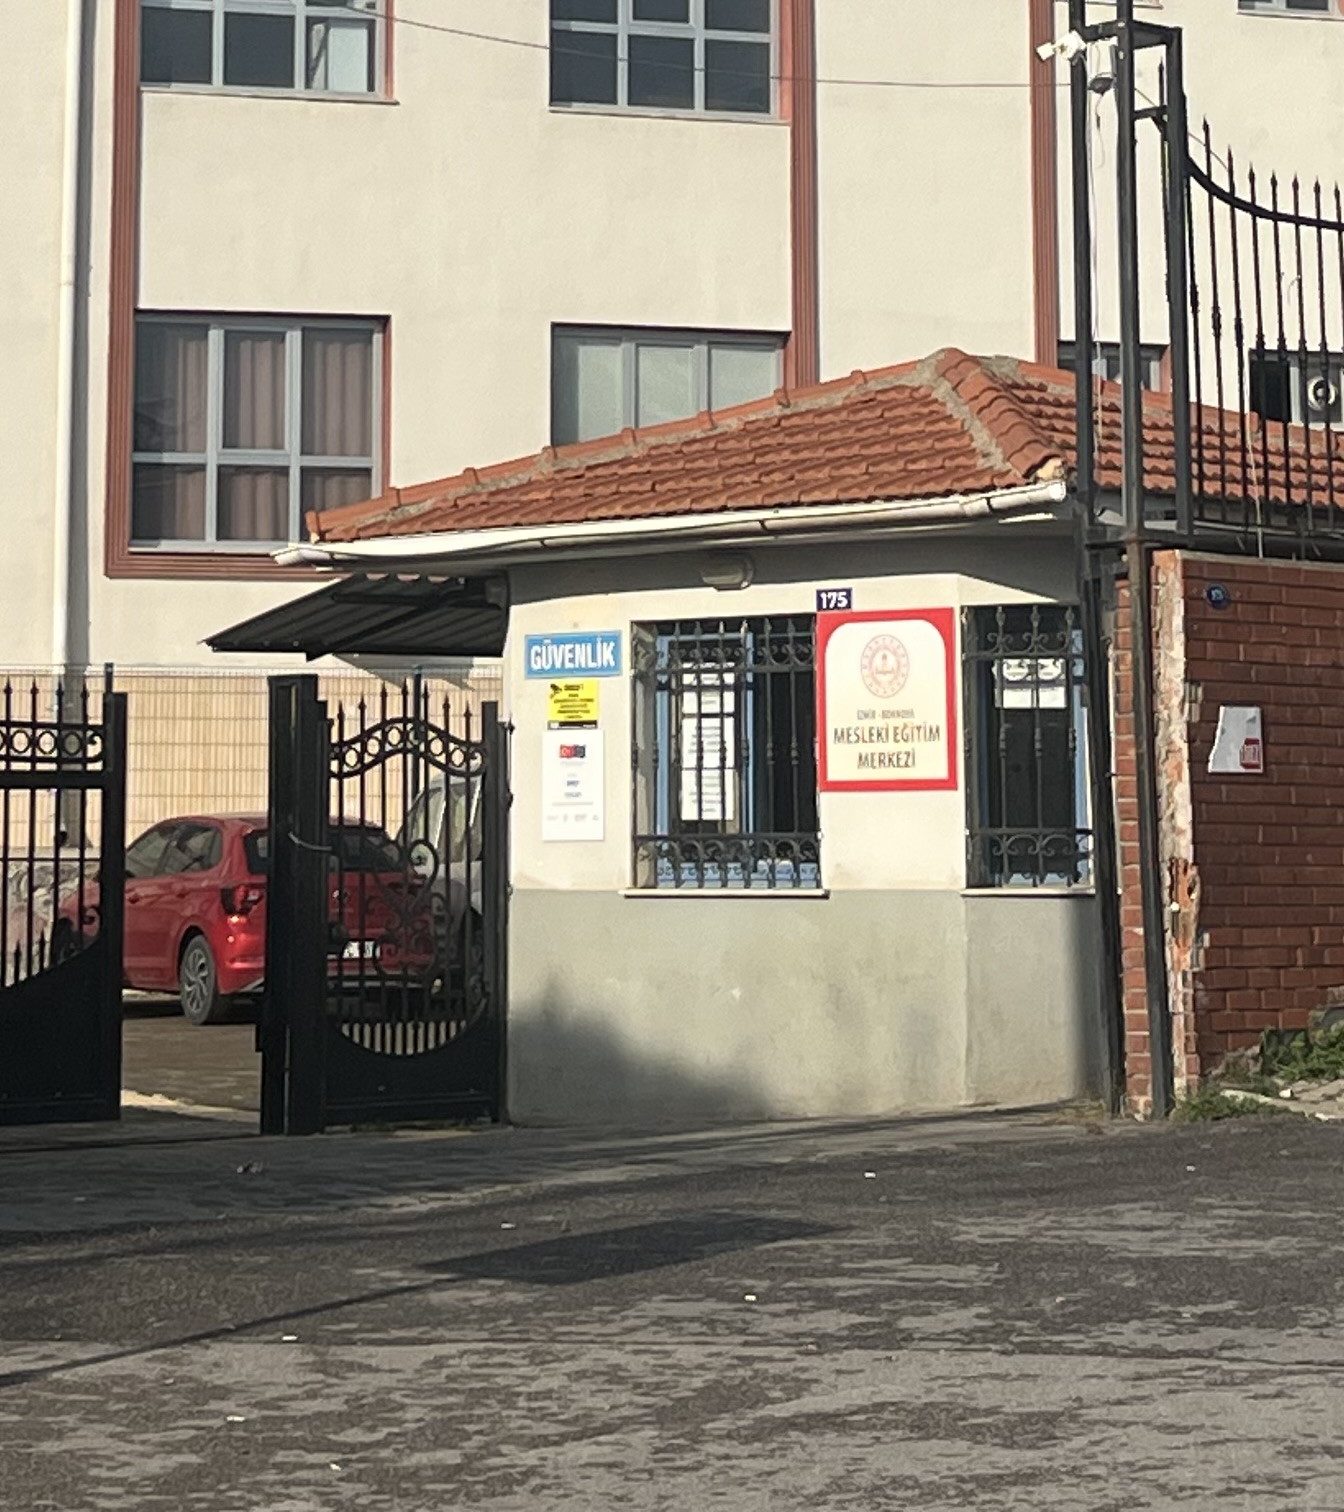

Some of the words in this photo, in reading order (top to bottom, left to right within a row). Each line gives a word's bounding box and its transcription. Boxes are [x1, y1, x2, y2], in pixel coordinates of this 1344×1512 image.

[820, 591, 849, 609] 175
[530, 637, 616, 671] GÜVENLİK
[833, 722, 889, 745] MESLEKİ
[892, 722, 941, 744] EĞİTİM
[857, 748, 916, 770] MERKEZİ
